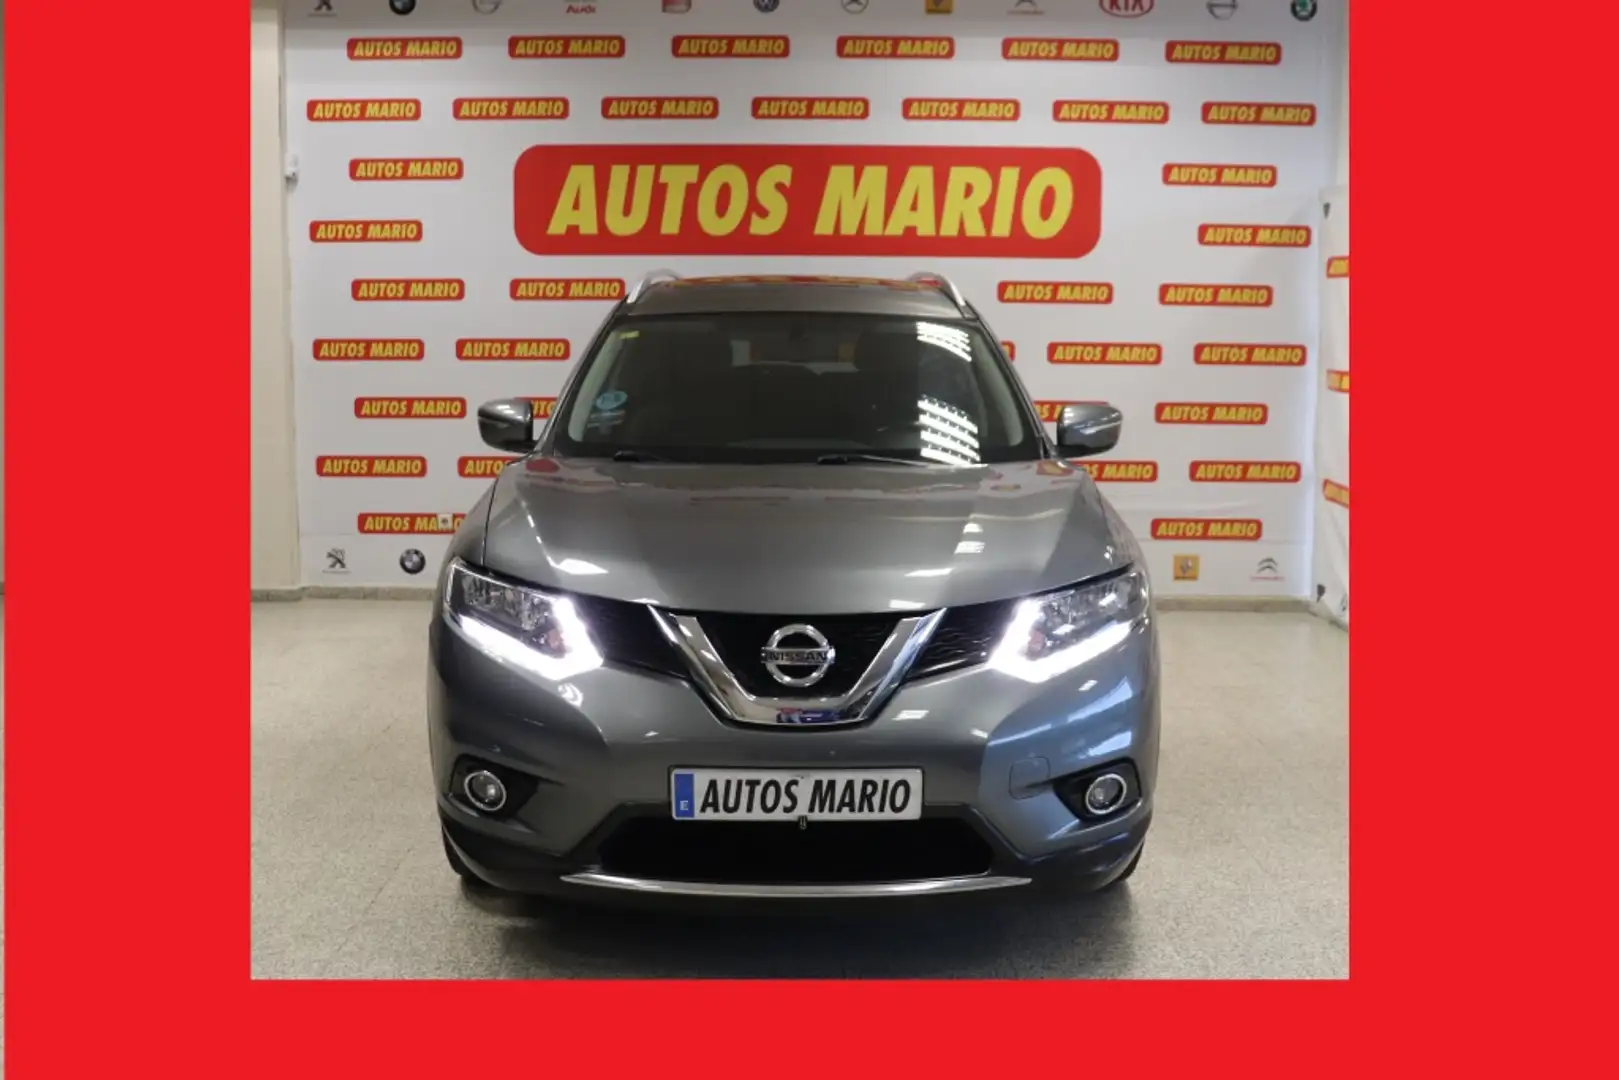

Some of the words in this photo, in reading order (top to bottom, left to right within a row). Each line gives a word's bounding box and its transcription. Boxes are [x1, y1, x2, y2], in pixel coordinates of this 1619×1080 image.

[354, 42, 402, 56] AUTOS
[405, 42, 457, 56] MARIO
[514, 41, 564, 53] AUTOS
[567, 41, 620, 53] MARIO
[678, 41, 729, 52] AUTOS
[730, 40, 785, 52] MARIO
[844, 40, 892, 54] AUTOS
[897, 41, 949, 55] MARIO
[1009, 41, 1058, 57] AUTOS
[1061, 43, 1114, 58] MARIO
[1173, 46, 1221, 59] AUTOS
[1225, 47, 1276, 60] MARIO
[312, 102, 362, 118] AUTOS
[364, 102, 417, 118] MARIO
[459, 101, 509, 116] AUTOS
[511, 101, 564, 116] MARIO
[608, 102, 656, 115] AUTOS
[661, 102, 714, 114] MARIO
[758, 102, 808, 115] AUTOS
[811, 101, 865, 116] MARIO
[908, 101, 959, 117] AUTOS
[961, 102, 1016, 119] MARIO
[1059, 103, 1109, 120] AUTOS
[1111, 105, 1165, 120] MARIO
[1209, 106, 1257, 120] AUTOS
[1260, 107, 1311, 122] MARIO
[355, 162, 404, 177] AUTOS
[406, 161, 459, 177] MARIO
[1168, 167, 1219, 183] AUTOS
[1220, 168, 1273, 184] MARIO
[546, 164, 793, 237] AUTOS
[813, 165, 1075, 240] MARIO
[315, 224, 364, 239] AUTOS
[366, 223, 418, 239] MARIO
[1204, 227, 1253, 243] AUTOS
[1255, 228, 1308, 244] MARIO
[358, 282, 405, 297] AUTOS
[408, 282, 460, 297] MARIO
[517, 282, 565, 297] AUTOS
[569, 282, 621, 296] MARIO
[1003, 284, 1054, 300] AUTOS
[1055, 285, 1110, 301] MARIO
[1165, 287, 1215, 303] AUTOS
[1216, 288, 1269, 303] MARIO
[319, 343, 366, 357] AUTOS
[369, 343, 420, 357] MARIO
[462, 342, 510, 356] AUTOS
[514, 342, 565, 356] MARIO
[1053, 345, 1103, 361] AUTOS
[1105, 346, 1158, 362] MARIO
[1199, 347, 1249, 362] AUTOS
[1251, 348, 1303, 362] MARIO
[361, 401, 407, 415] AUTOS
[411, 401, 462, 415] MARIO
[1160, 406, 1210, 421] AUTOS
[1211, 407, 1264, 421] MARIO
[323, 459, 369, 473] AUTOS
[372, 460, 422, 473] MARIO
[464, 460, 505, 475] AUTO
[1101, 464, 1154, 479] MARIO
[1195, 464, 1244, 479] AUTOS
[1245, 465, 1297, 479] MARIO
[364, 517, 411, 530] AUTOS
[1157, 522, 1205, 536] AUTOS
[1207, 522, 1258, 537] MARIO
[770, 651, 828, 661] NISSAN
[700, 779, 799, 814] AUTOS
[808, 779, 911, 814] MARIO
[679, 800, 689, 811] E
